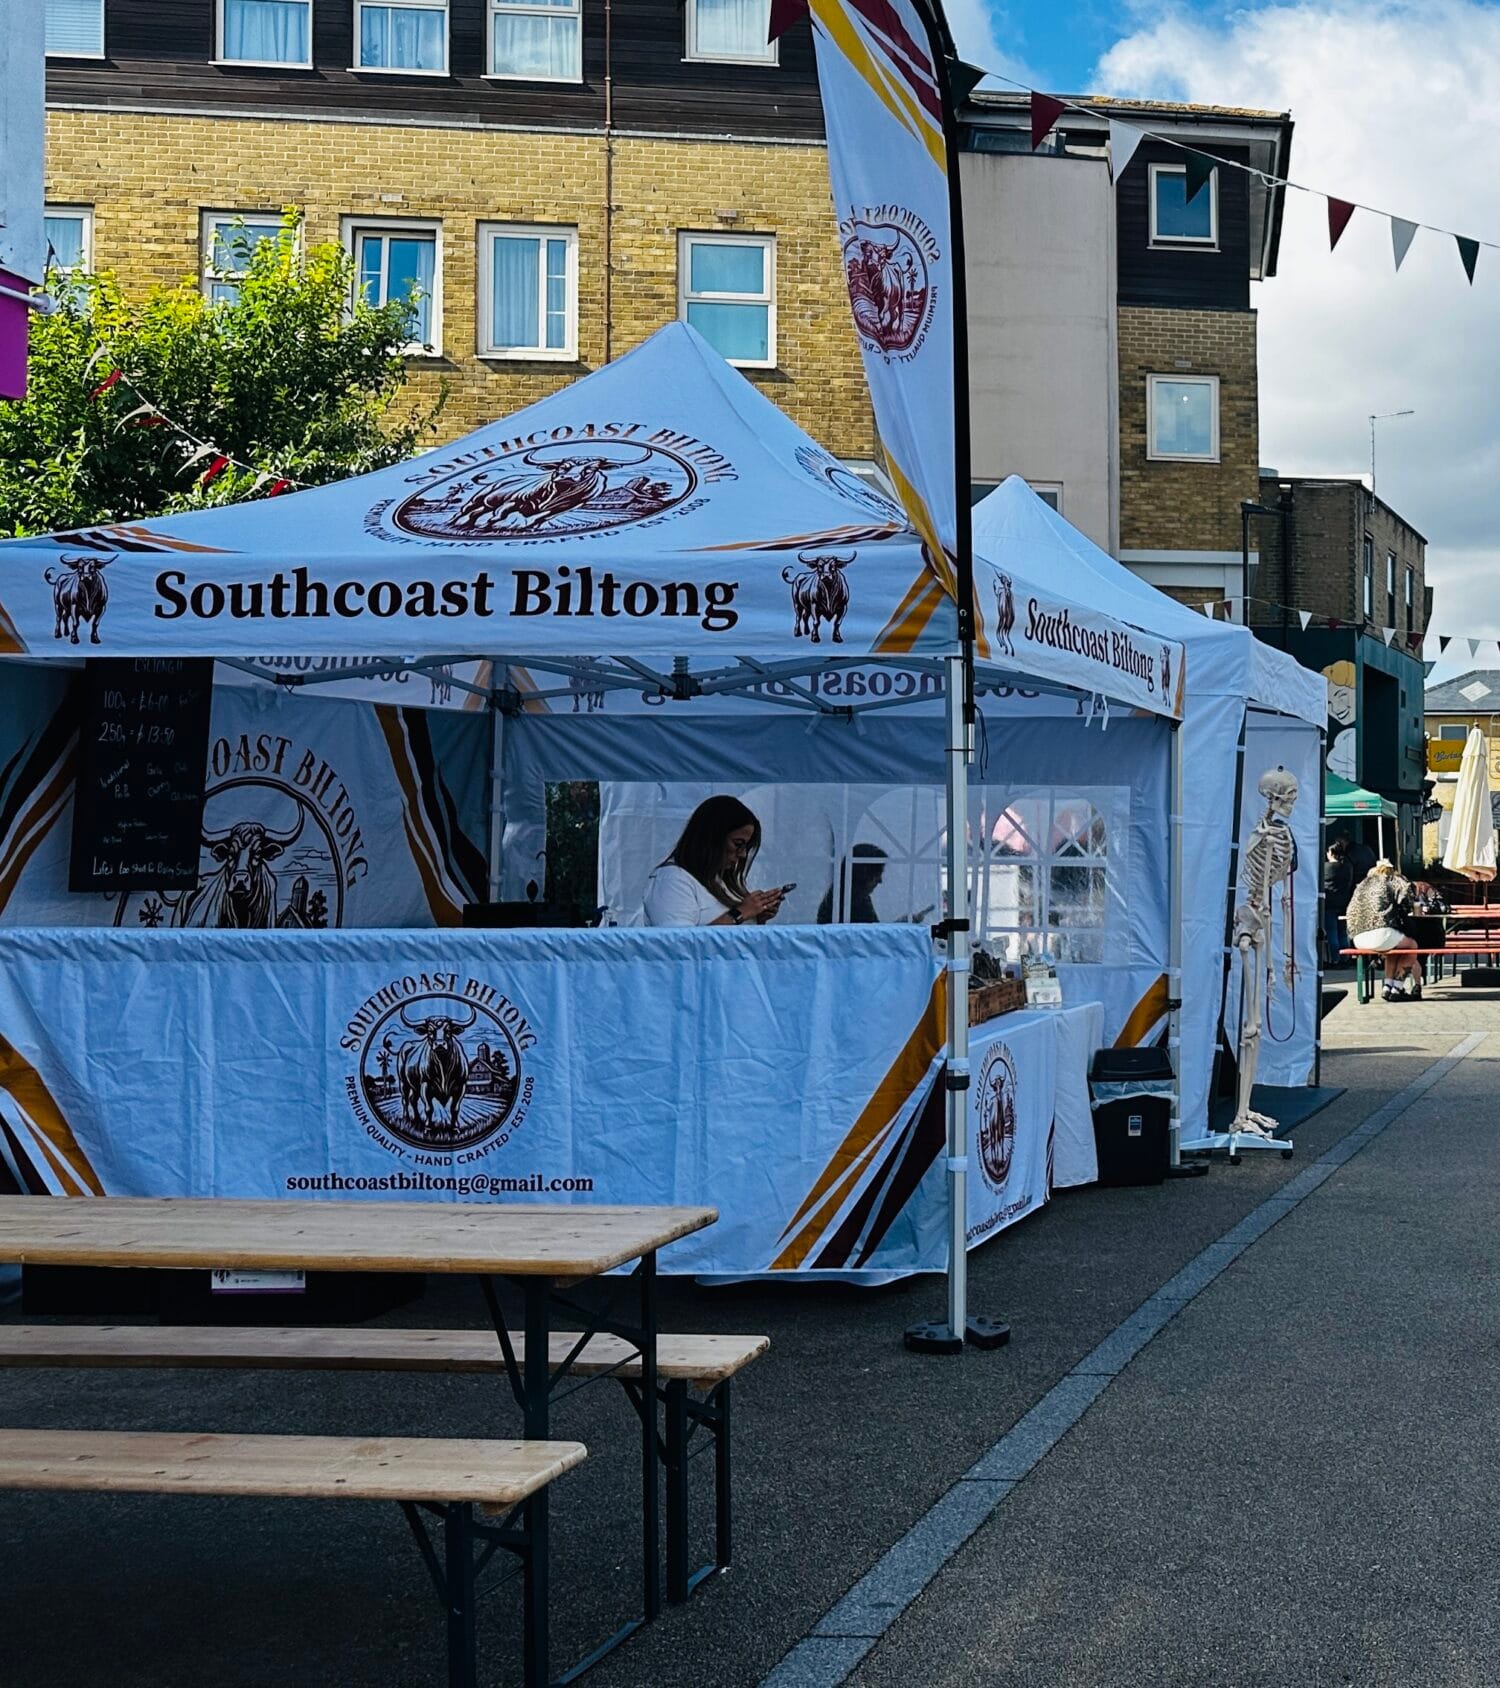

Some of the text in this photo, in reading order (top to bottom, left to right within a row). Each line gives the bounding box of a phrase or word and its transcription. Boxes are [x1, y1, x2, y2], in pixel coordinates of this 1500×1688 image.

[404, 422, 740, 484] SOUTHCOAST BILTONG
[505, 529, 620, 547] CRAFTED
[154, 566, 739, 631] Southcoast Biltong
[1024, 598, 1155, 692] Southcoast Biltong
[293, 748, 368, 890] BILTONG
[340, 972, 538, 1052] SOUTHCOAST BILTONG
[344, 1075, 370, 1125] PREMIUM
[365, 1124, 406, 1158] QUALITY
[414, 1154, 453, 1167] HAND
[456, 1133, 510, 1165] CRAFTED
[521, 1075, 536, 1107] 2008
[286, 1172, 593, 1196] southcoastbiltong@gmail.com
